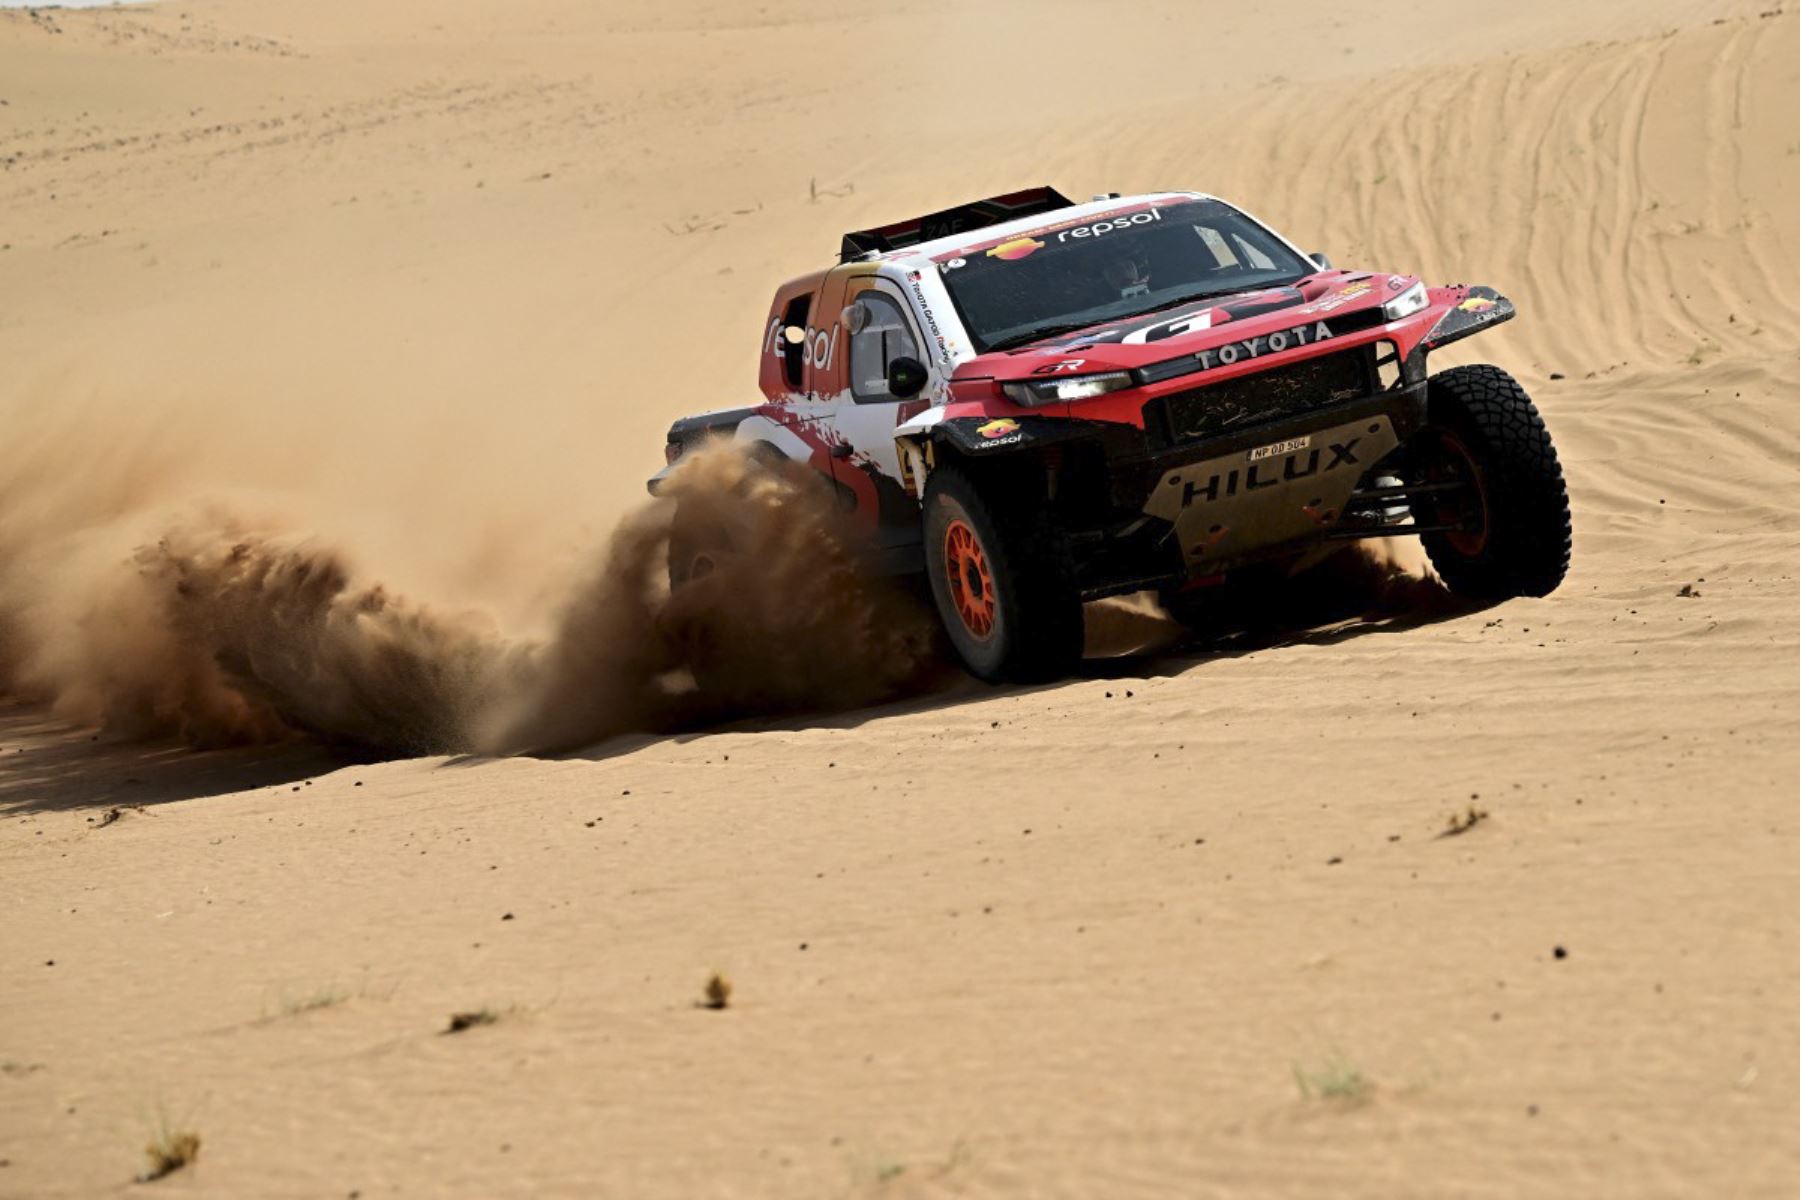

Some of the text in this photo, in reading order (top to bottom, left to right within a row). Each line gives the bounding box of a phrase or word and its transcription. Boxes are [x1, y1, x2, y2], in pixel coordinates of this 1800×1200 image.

[1058, 207, 1162, 242] repsol
[765, 318, 839, 372] resol
[1031, 359, 1087, 375] GR
[1195, 320, 1334, 370] TOYOTA
[1182, 438, 1360, 509] HILUX
